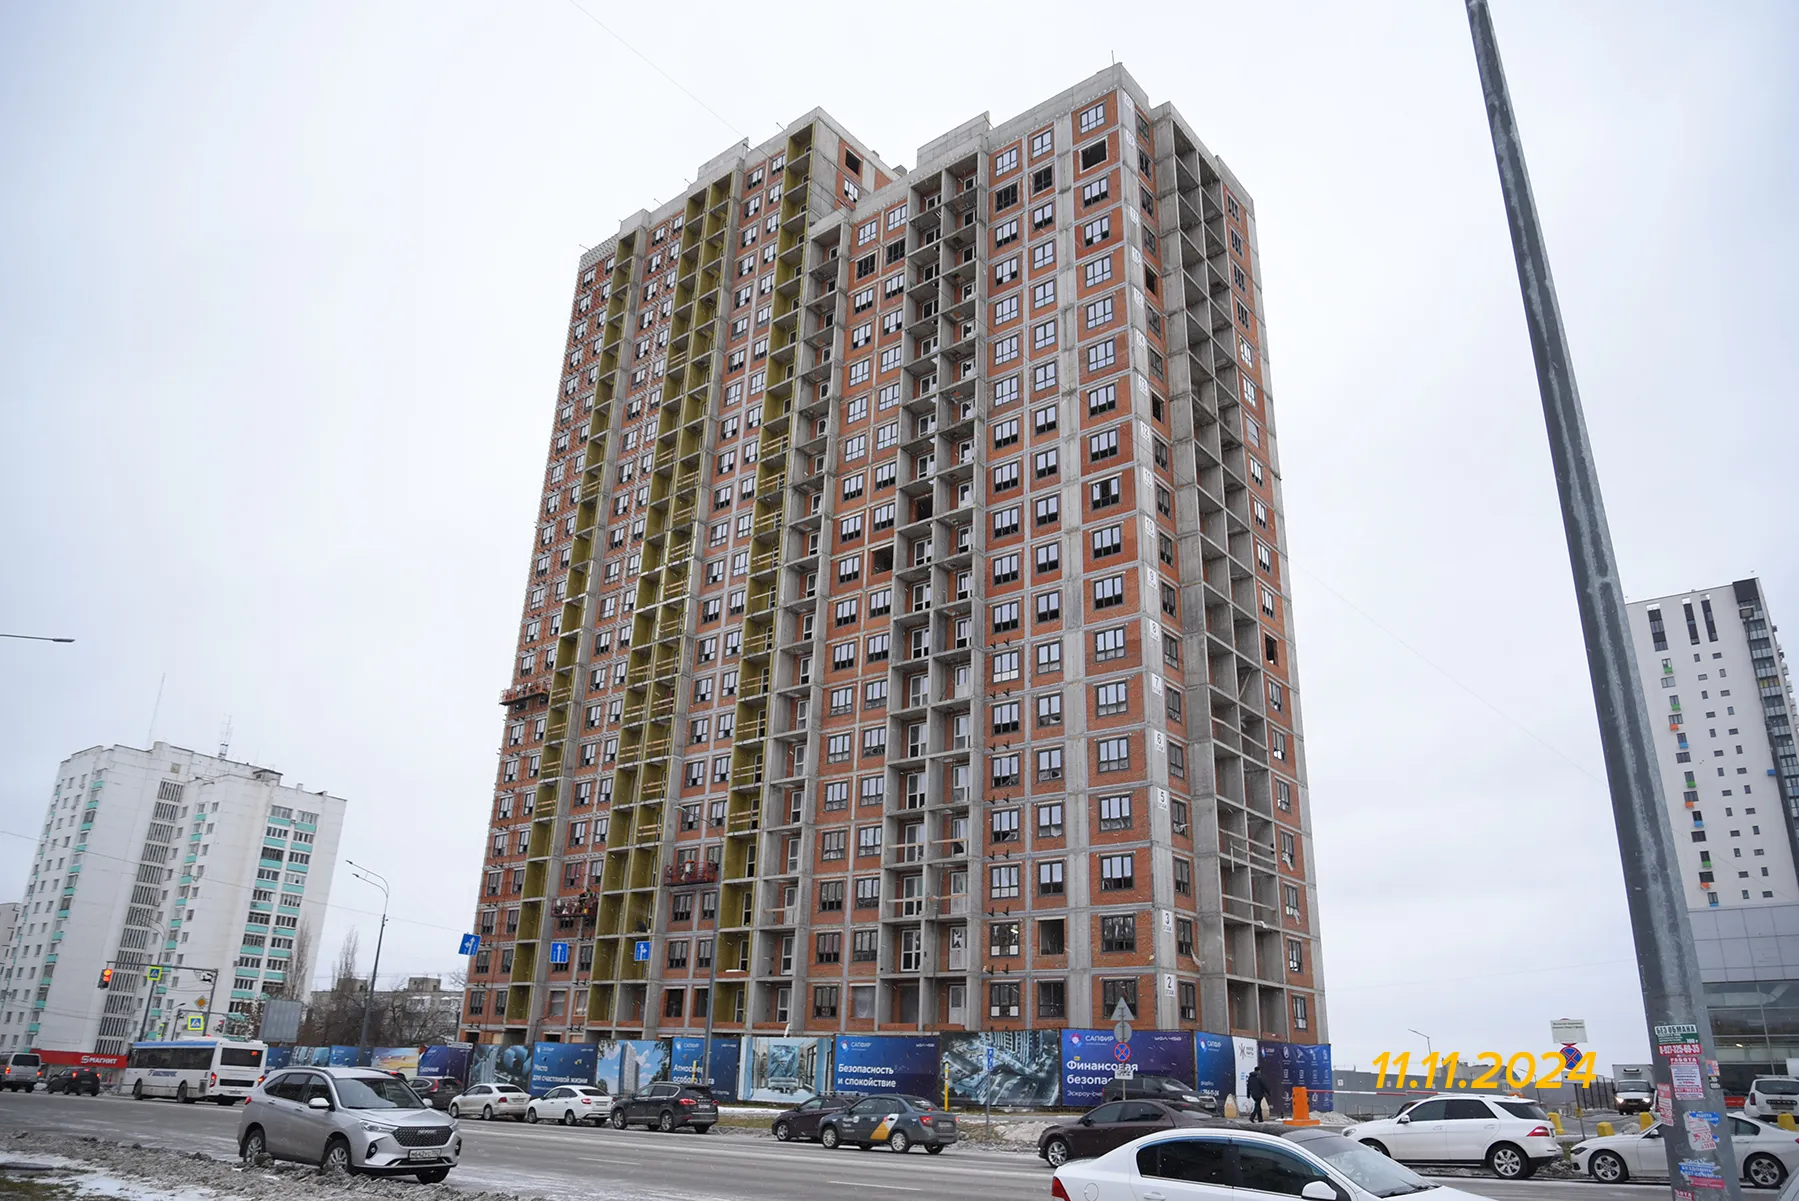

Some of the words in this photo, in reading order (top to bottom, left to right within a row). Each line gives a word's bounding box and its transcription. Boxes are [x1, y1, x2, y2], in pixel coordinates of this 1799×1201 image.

[1165, 912, 1170, 925] 3
[1167, 976, 1172, 989] 2
[838, 1064, 894, 1075] Безопасность
[542, 1075, 570, 1083] счастливой
[844, 1077, 896, 1087] спокойствие
